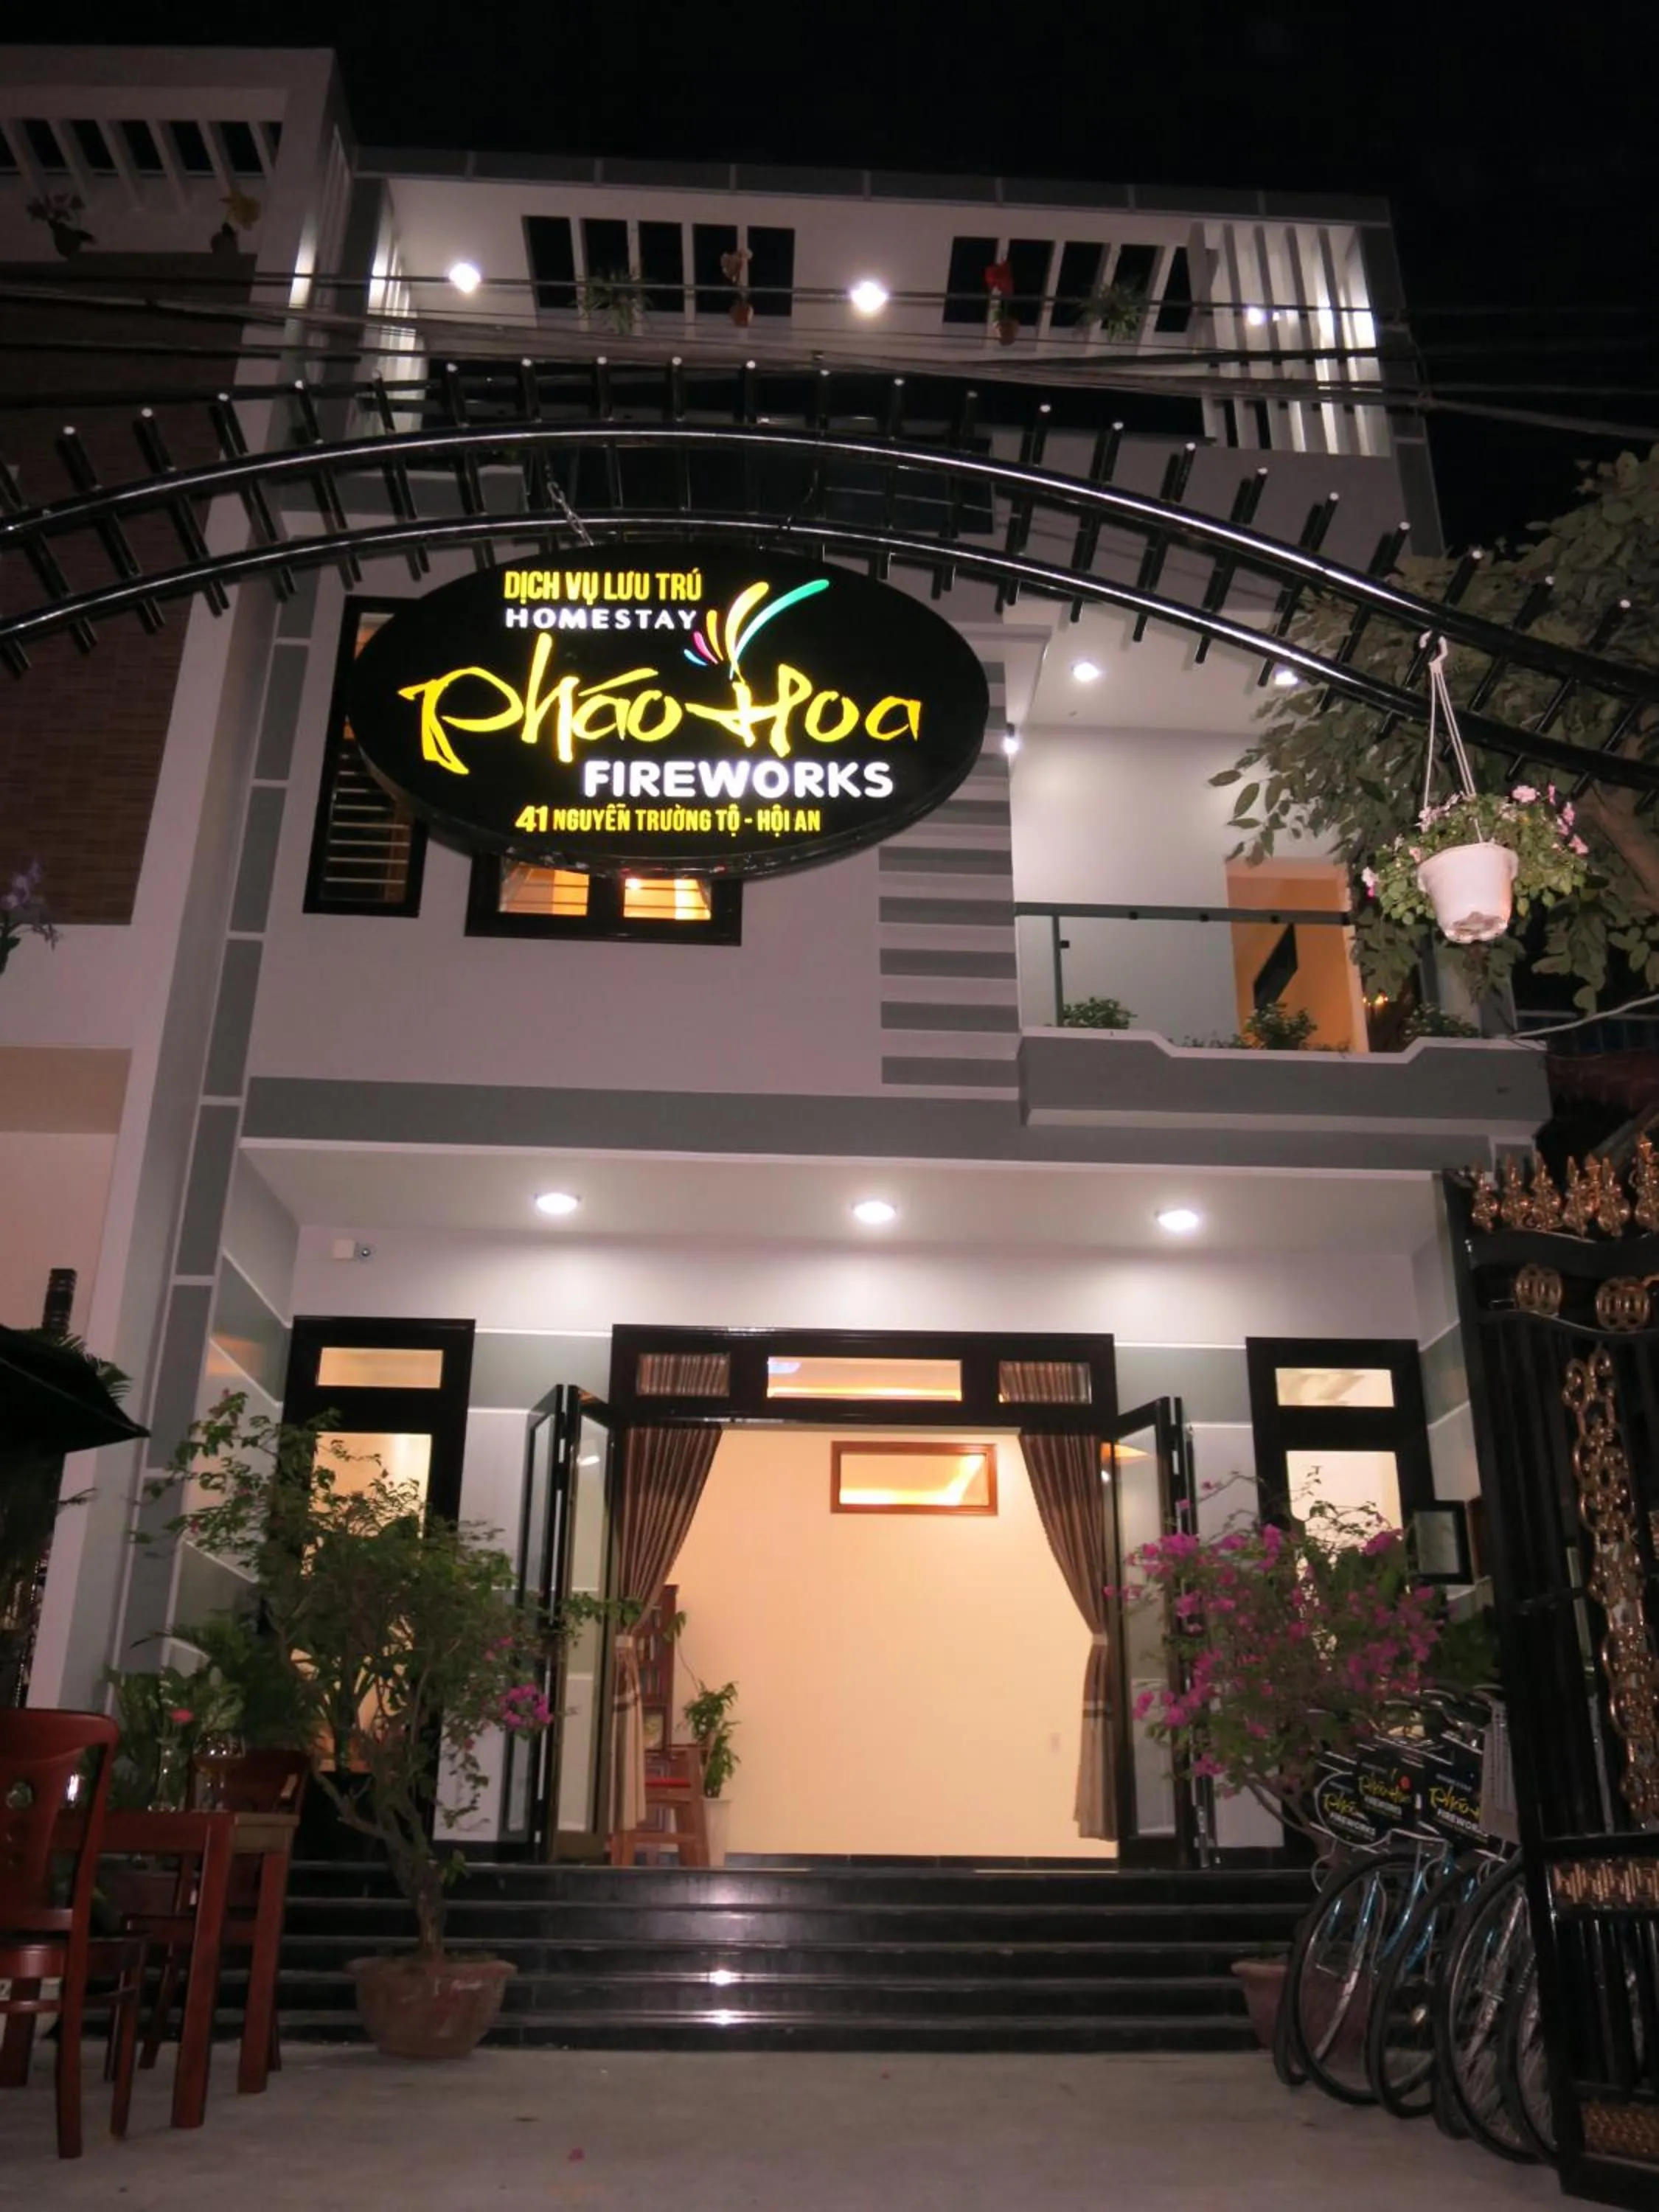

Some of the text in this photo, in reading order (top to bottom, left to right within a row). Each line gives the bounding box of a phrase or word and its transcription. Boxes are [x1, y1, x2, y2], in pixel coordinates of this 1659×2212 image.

[504, 568, 702, 605] DỊCH VỤ LƯU TRÚ
[505, 608, 697, 630] HOMESTAY
[684, 664, 922, 757] Hoa
[583, 760, 894, 798] FIREWORKS
[515, 805, 549, 832] 41
[552, 803, 630, 832] NGUYỄN
[634, 803, 712, 832] TRƯỜNG
[714, 803, 740, 837] TỘ
[757, 803, 790, 838] HỘI
[794, 810, 821, 832] AN
